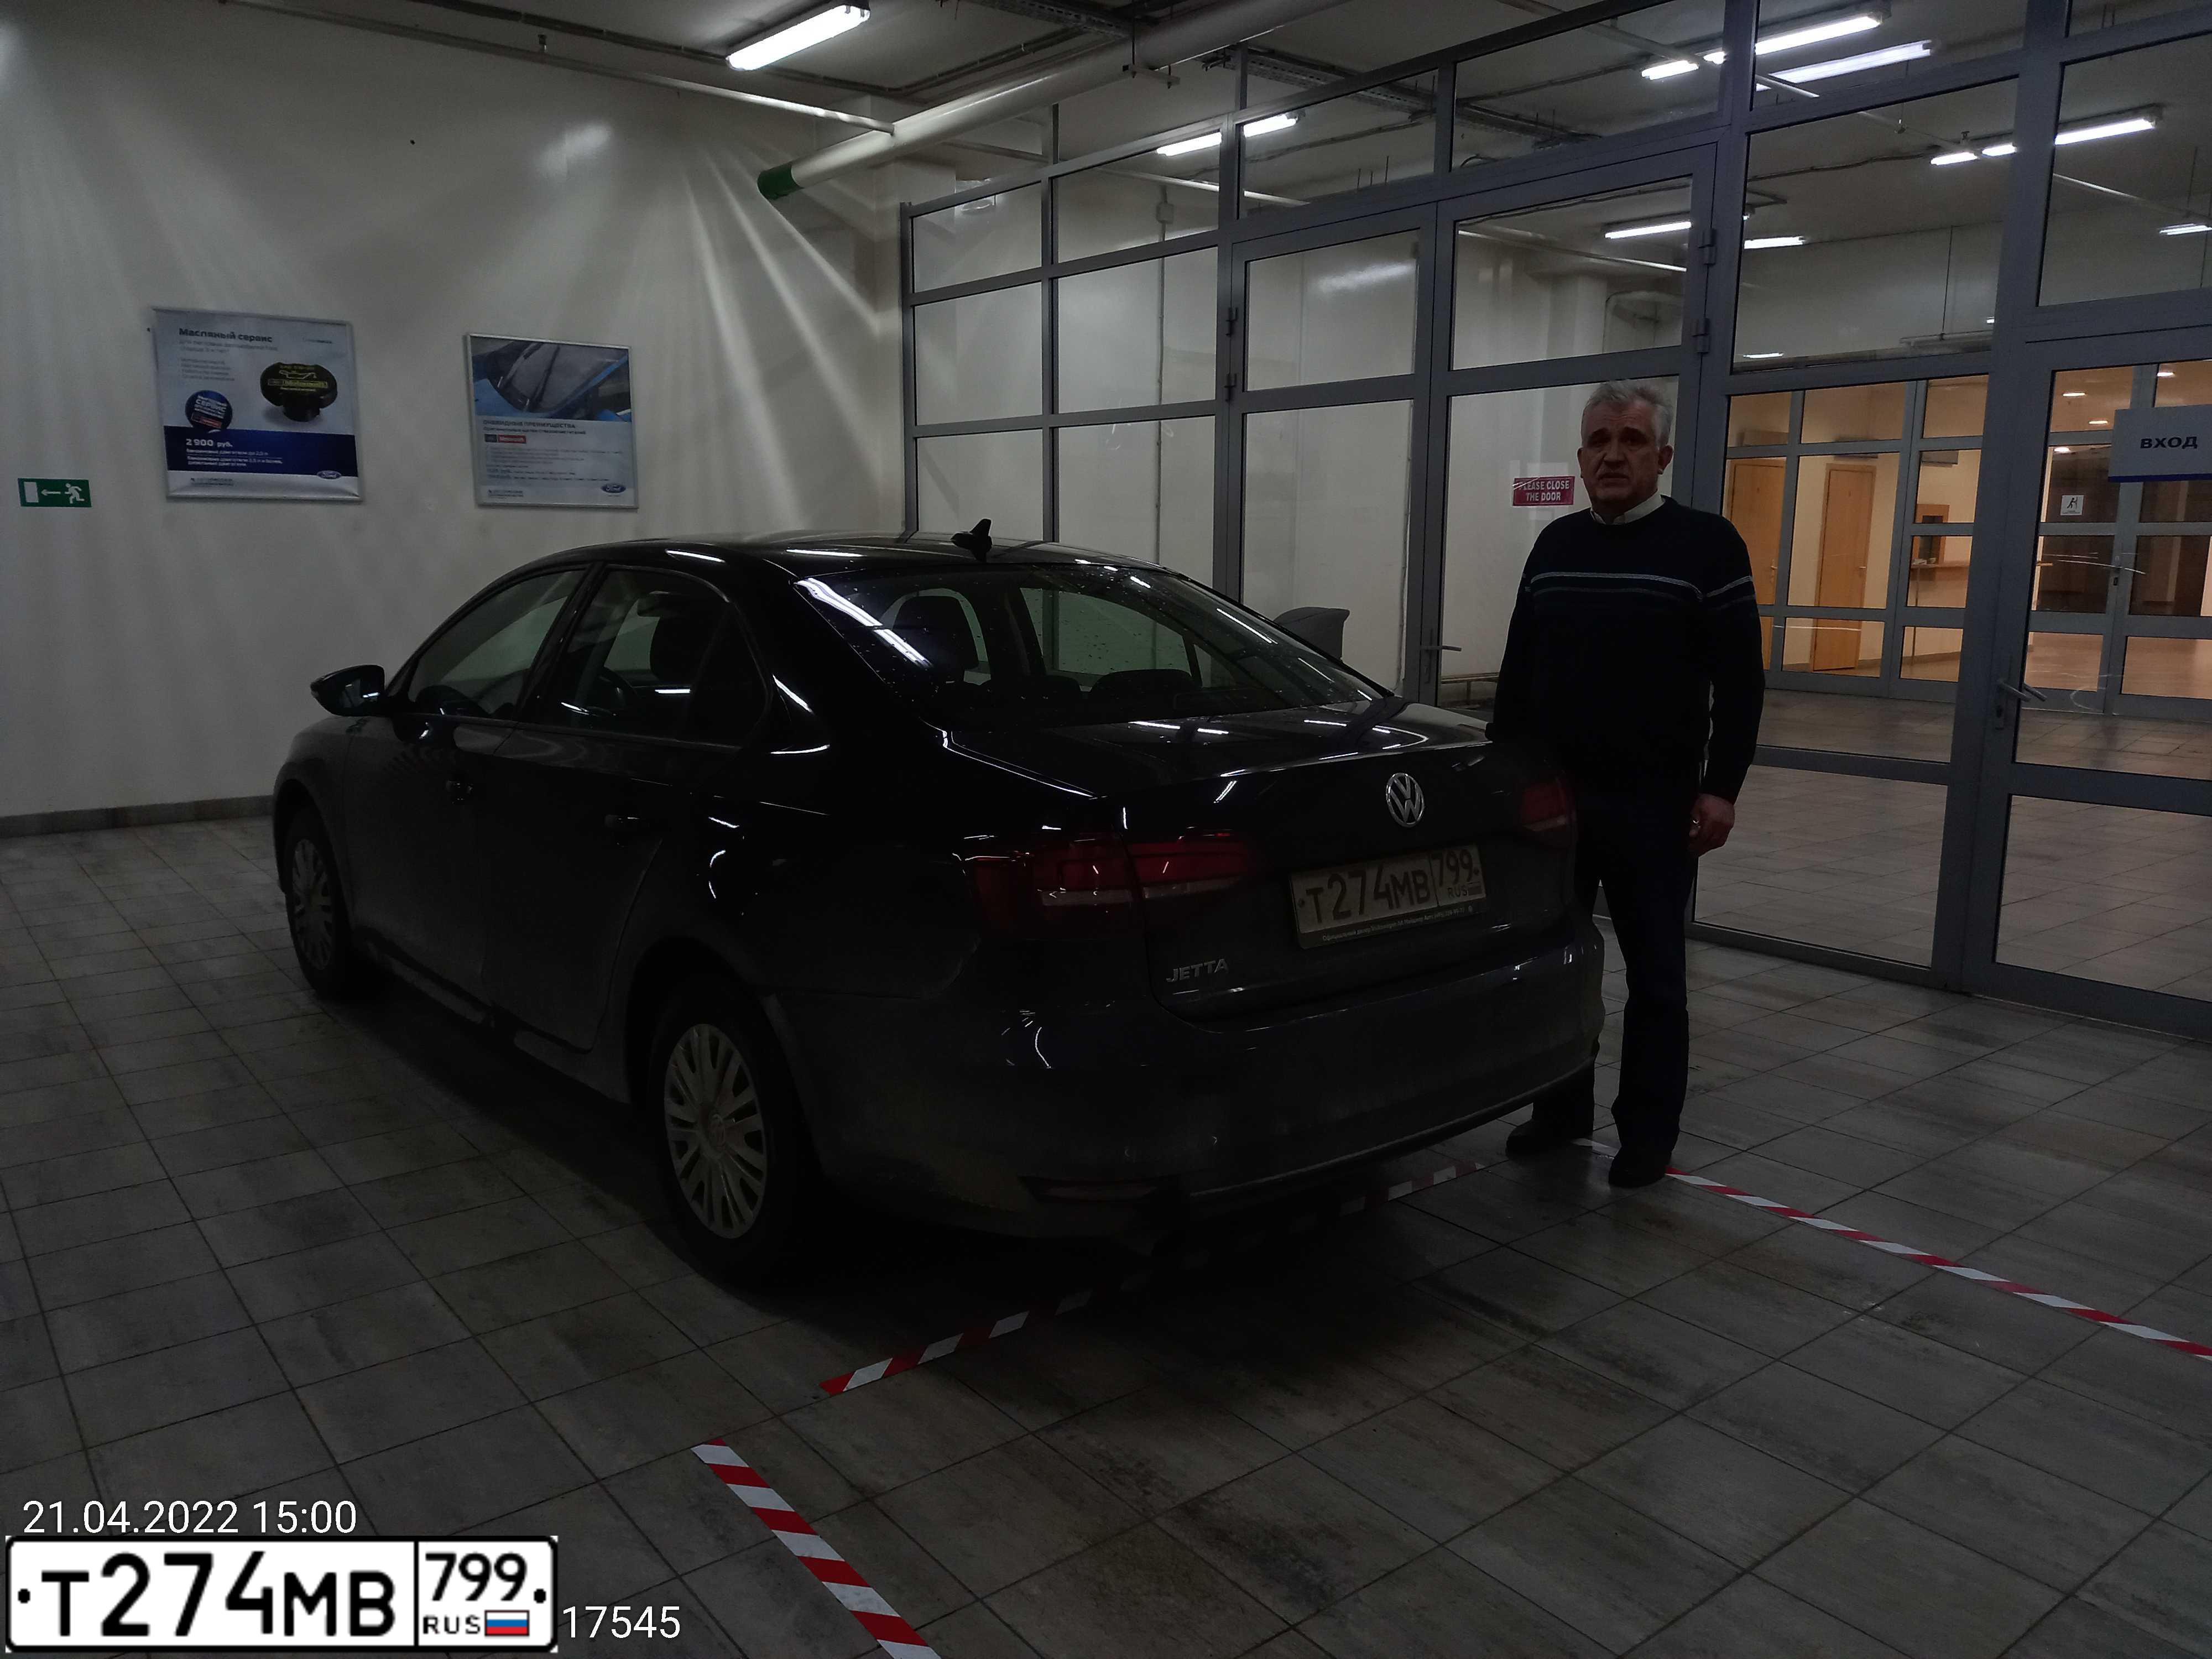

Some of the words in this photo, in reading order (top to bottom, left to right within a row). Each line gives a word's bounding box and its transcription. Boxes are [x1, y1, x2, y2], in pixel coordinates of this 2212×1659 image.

[179, 328, 236, 339] Масляный
[238, 333, 273, 343] сервис
[2140, 436, 2198, 449] ВХОД
[1546, 480, 1570, 491] CLOSE
[1526, 492, 1540, 502] THE
[1541, 492, 1561, 501] DOOR
[1431, 850, 1473, 888] 799
[1447, 885, 1468, 899] RUS
[1165, 958, 1229, 983] JETTA
